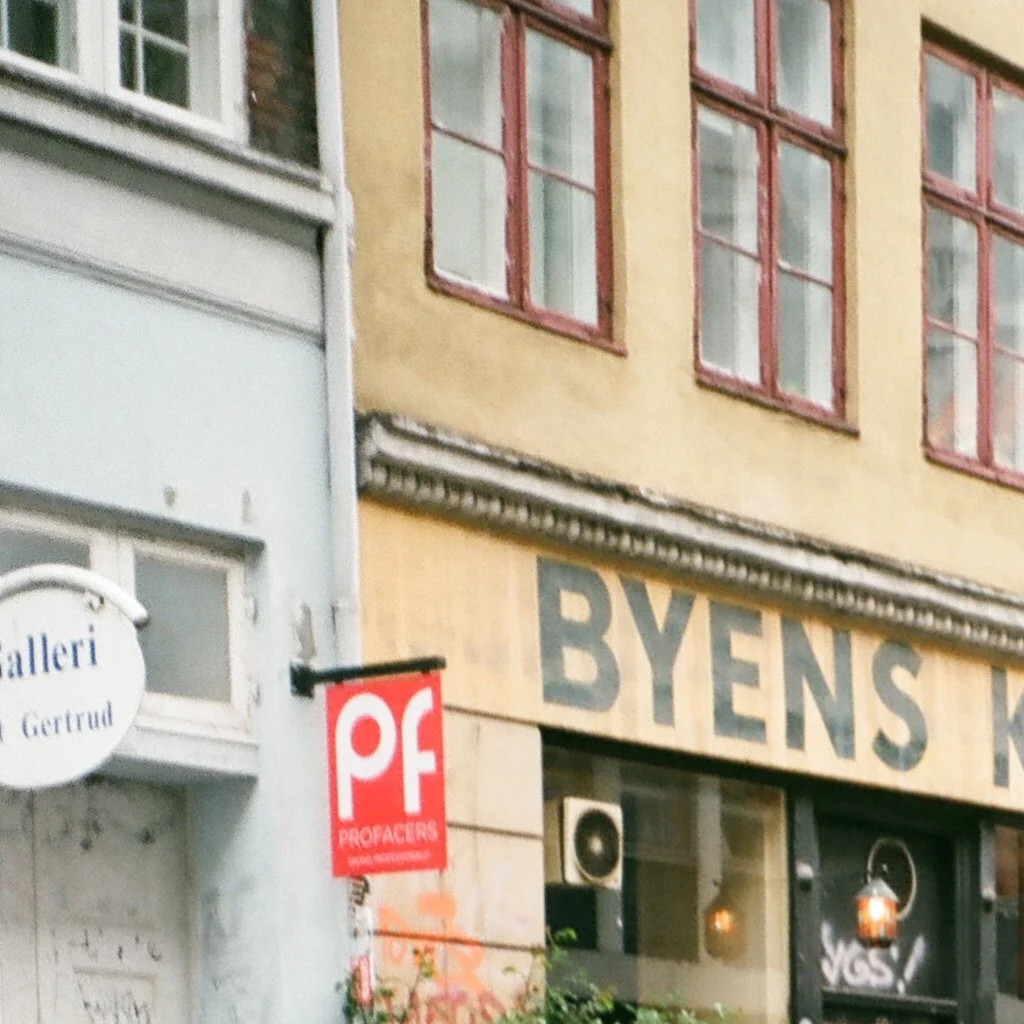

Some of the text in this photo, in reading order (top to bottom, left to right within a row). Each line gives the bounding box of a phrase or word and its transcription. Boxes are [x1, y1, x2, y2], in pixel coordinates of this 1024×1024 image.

[0, 622, 97, 680] alleri
[536, 555, 928, 772] BYENS
[21, 700, 113, 739] Gertrud
[338, 820, 438, 849] PROFACERS
